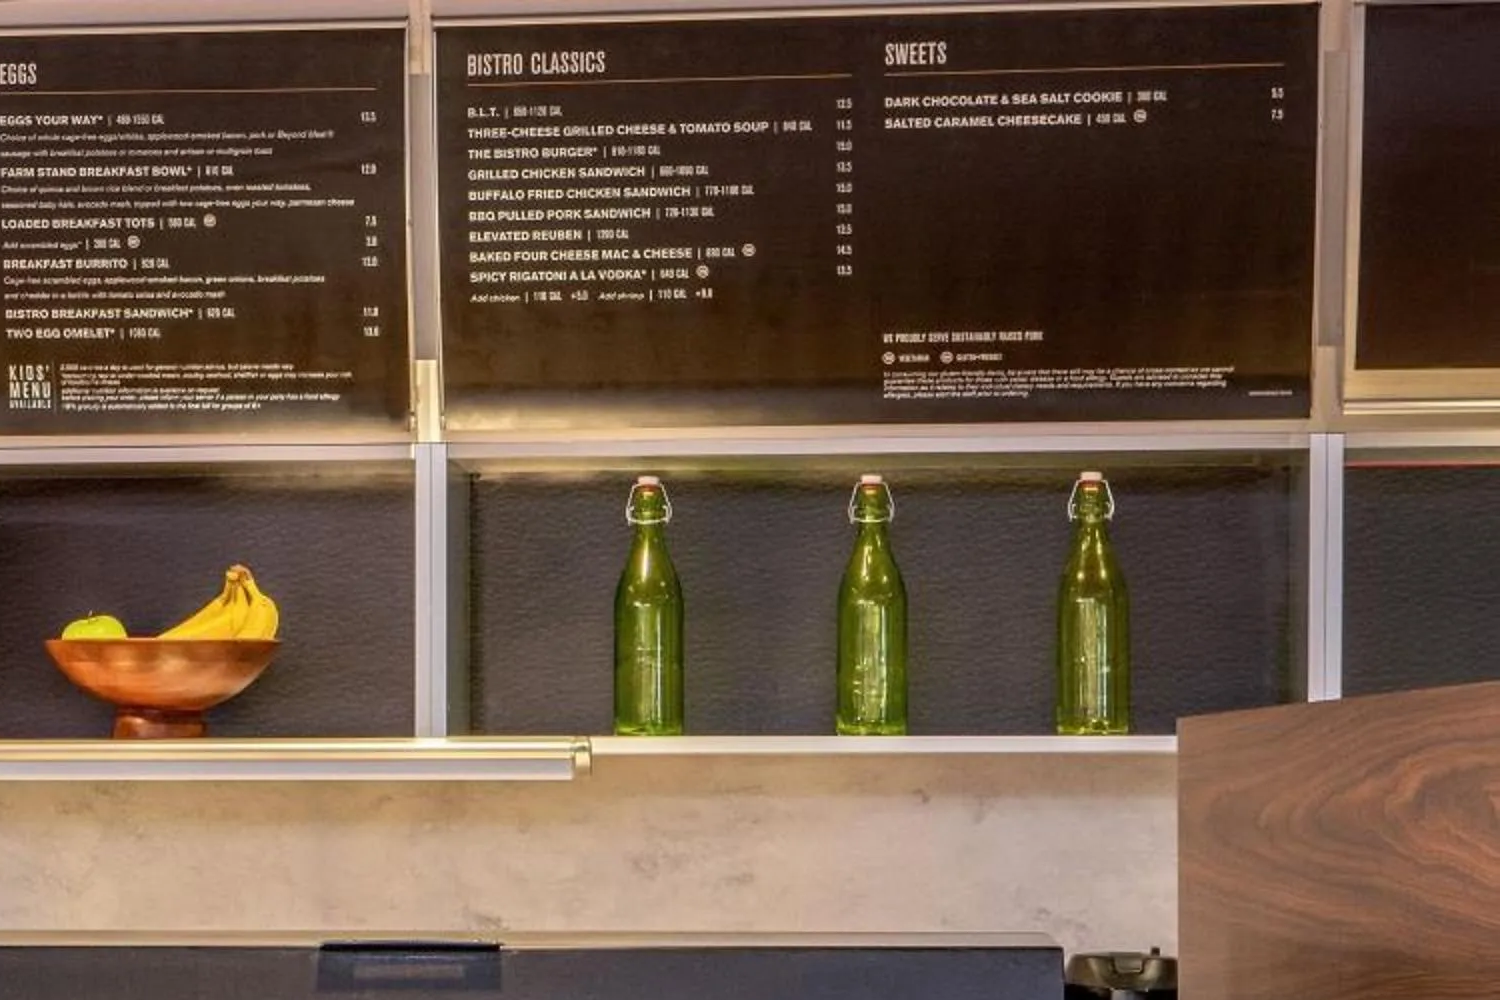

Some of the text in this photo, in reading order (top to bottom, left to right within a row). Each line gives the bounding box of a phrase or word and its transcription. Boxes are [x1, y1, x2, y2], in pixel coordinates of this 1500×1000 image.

[885, 42, 947, 66] SWEETS
[468, 51, 606, 76] BISTRO CLASSICS
[0, 63, 37, 85] EGGS
[885, 92, 1122, 108] DARK CHOCOLATE & SEA SALT COOKIE
[468, 107, 500, 118] B.L.T.
[0, 116, 32, 126] EGGS
[36, 116, 68, 126] YOUR
[884, 114, 1082, 129] SALTED CARAMEL CHEESECAKE
[468, 122, 769, 138] THREE-CHEESE GRILLED CHEESE & TOMATO SOUP
[468, 148, 492, 159] THE
[494, 148, 539, 158] BISTRO
[1, 167, 35, 178] FARM
[37, 167, 76, 177] STAND
[80, 166, 149, 177] BREAKFAST
[468, 166, 645, 180] GRILLED CHICKEN SANDWICH
[468, 187, 690, 200] BUFFALO FRIED CHICKEN SANDWICH
[498, 210, 544, 221] PULLED
[547, 209, 582, 220] PORK
[584, 208, 650, 219] SANDWICH
[2, 218, 155, 230] LOADED BREAKFAST TOTS
[469, 231, 530, 242] ELEVATED
[532, 230, 582, 241] REUBEN
[470, 252, 510, 262] BAKED
[514, 250, 548, 262] FOUR
[550, 250, 599, 261] CHEESE
[602, 250, 629, 260] MAC
[632, 250, 641, 259] &
[644, 248, 692, 259] CHEESE
[4, 258, 128, 270] BREAKFAST BURRITO
[470, 272, 507, 283] SPICY
[510, 271, 566, 282] RIGATONI
[570, 270, 578, 280] A
[581, 270, 596, 280] LA
[5, 309, 48, 320] BISTRO
[52, 309, 121, 319] BREAKFAST
[6, 328, 33, 339] TWO
[36, 328, 60, 338] EGG
[9, 382, 52, 398] MENU
